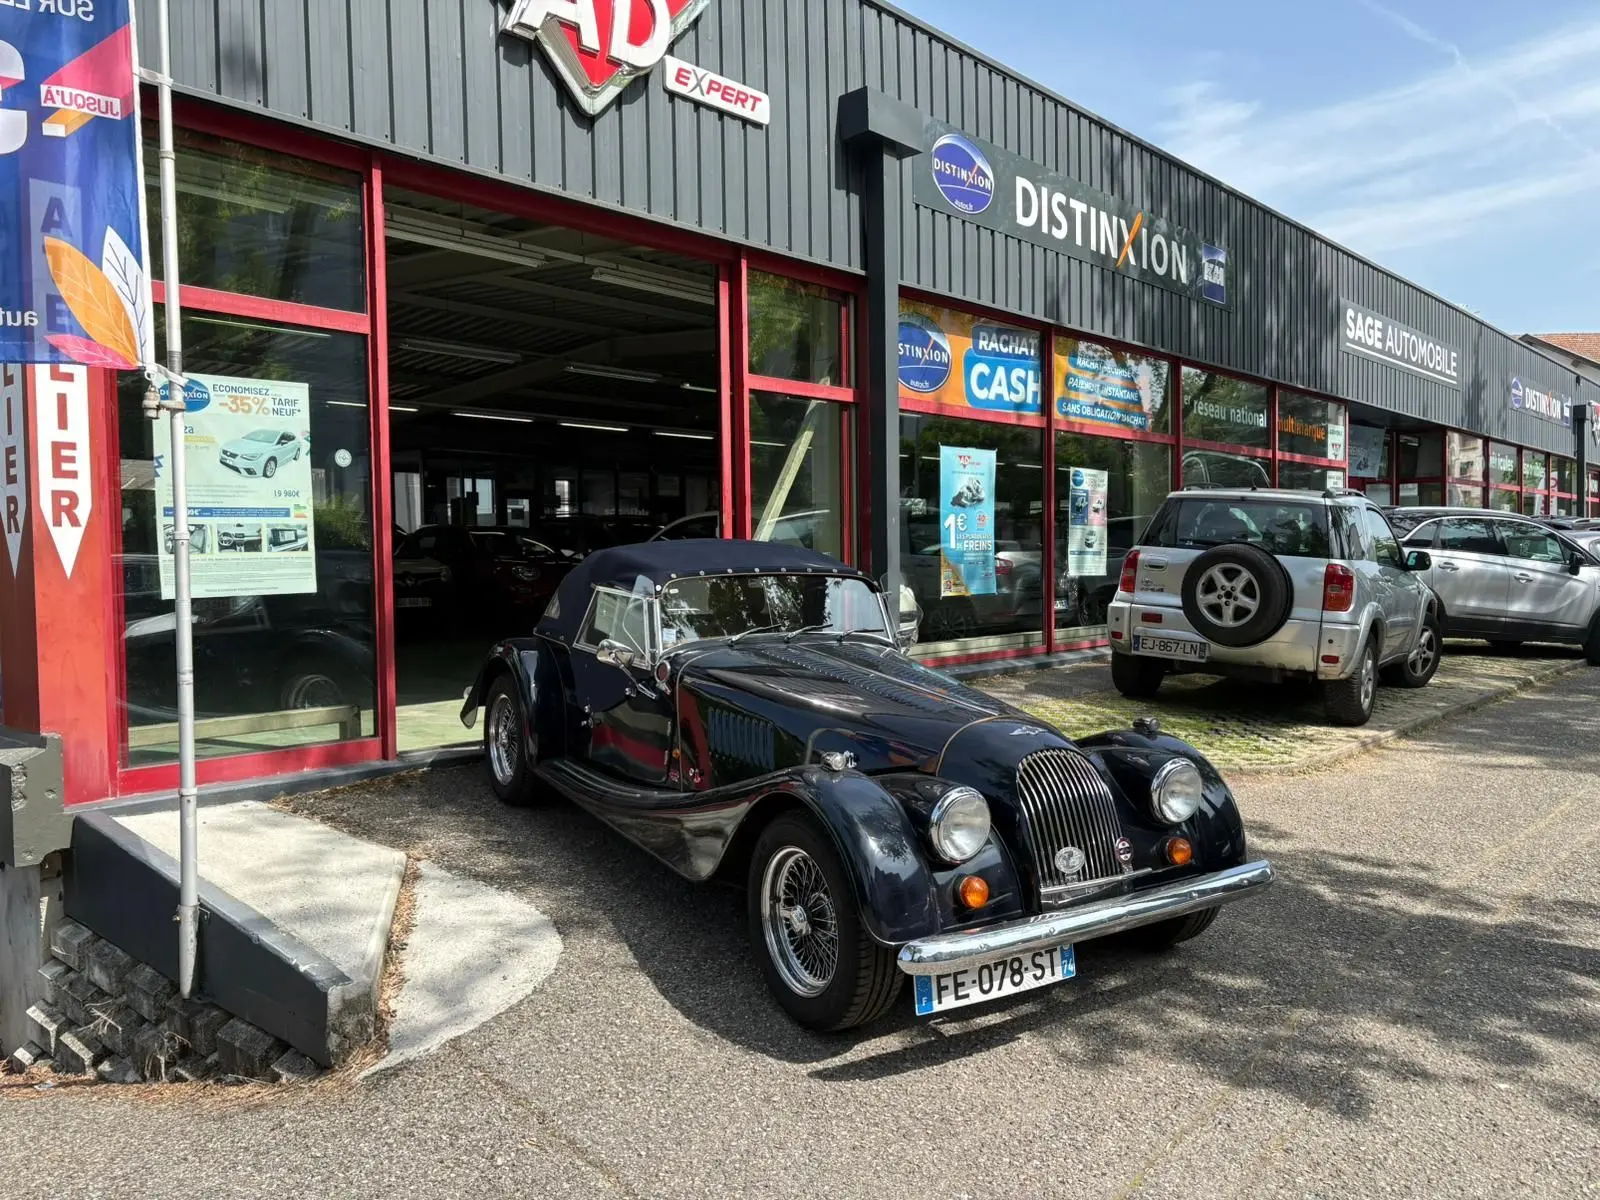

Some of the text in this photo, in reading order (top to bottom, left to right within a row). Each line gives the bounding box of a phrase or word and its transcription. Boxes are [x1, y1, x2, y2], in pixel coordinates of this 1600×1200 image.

[674, 66, 763, 112] EXPERT
[933, 157, 992, 191] DISTINXION
[1015, 175, 1188, 286] DISTINXION
[978, 331, 1037, 357] RACHAT
[1345, 308, 1458, 378] SAGE AUTOMOBILE
[159, 387, 209, 400] DINXION
[212, 384, 270, 397] ECONOMISEZ
[970, 362, 1041, 405] CASH
[219, 395, 299, 415] -35% TARIF
[1062, 403, 1080, 415] SANS
[1193, 396, 1226, 420] réseau
[1230, 405, 1267, 428] national
[963, 540, 992, 551] FREINS
[1140, 638, 1198, 656] EJ-867-LN
[936, 948, 1074, 1005] FE-078-ST 74
[922, 997, 928, 1007] F
